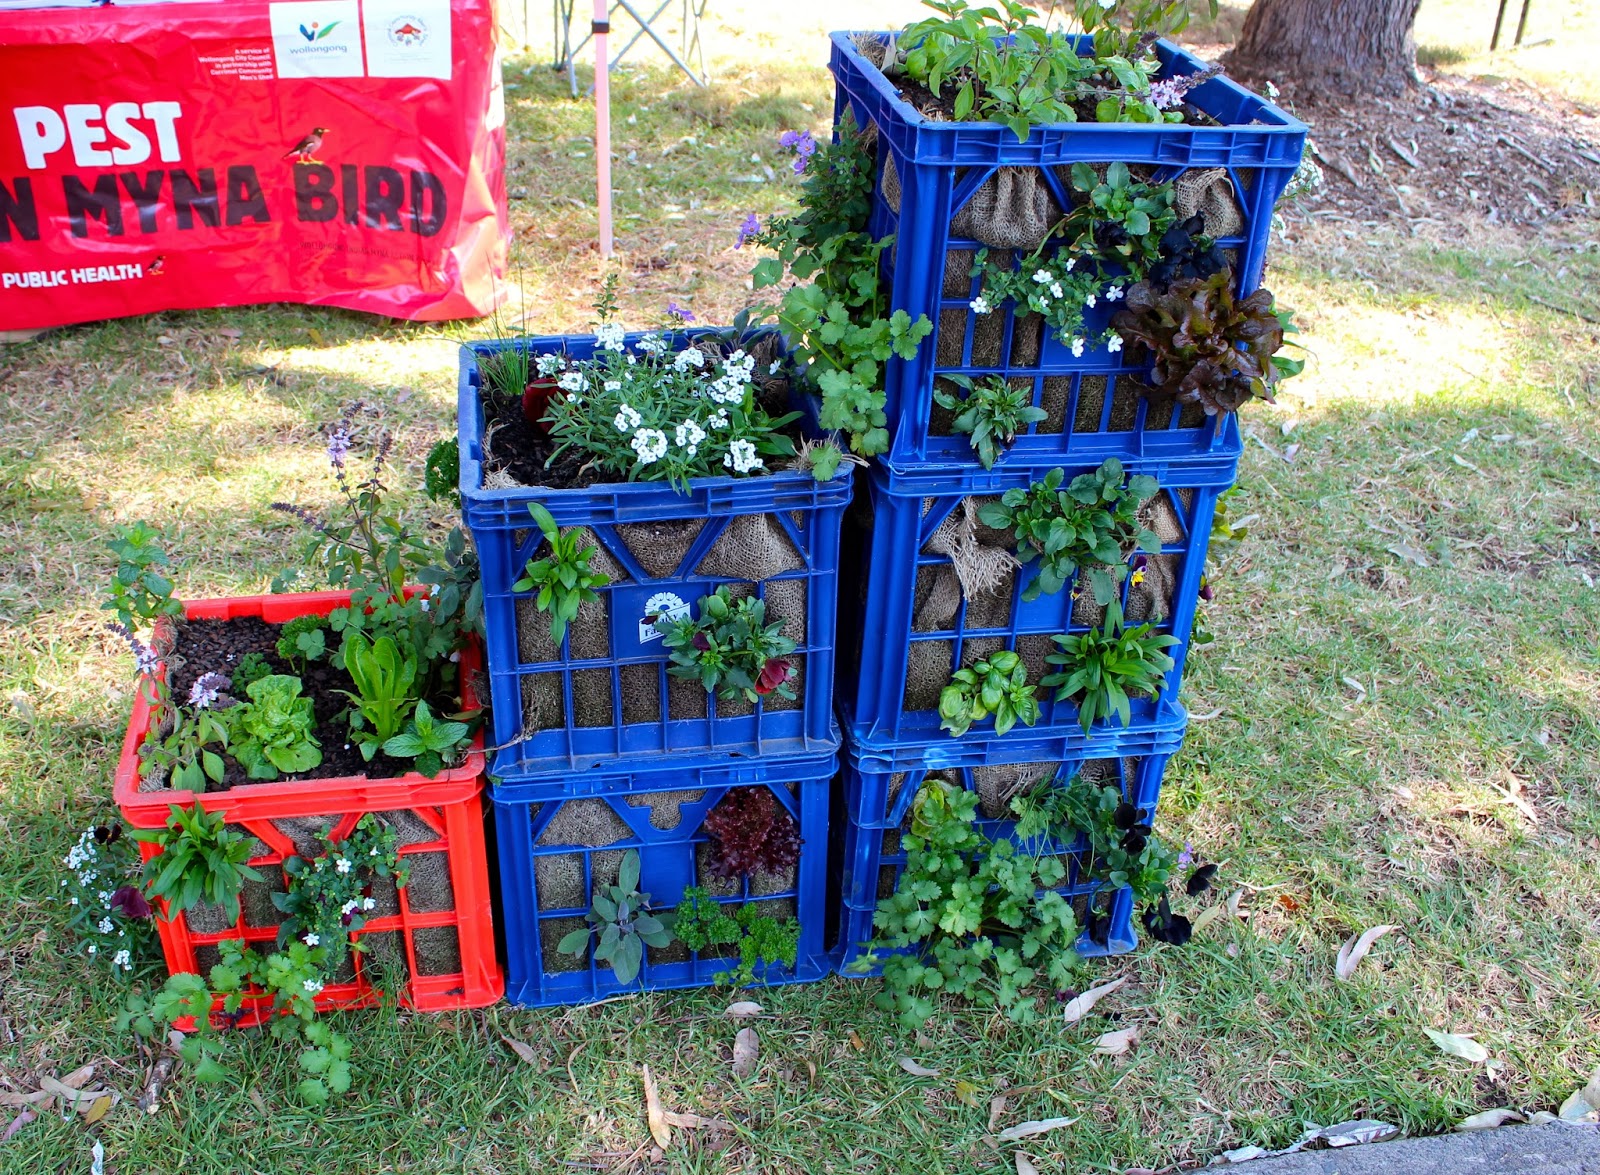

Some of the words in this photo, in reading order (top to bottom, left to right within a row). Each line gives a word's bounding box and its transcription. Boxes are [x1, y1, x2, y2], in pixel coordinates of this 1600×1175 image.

[289, 45, 348, 54] wollongong
[14, 101, 182, 170] PEST
[62, 165, 271, 238] MYNA
[293, 163, 448, 238] BIRD
[2, 268, 68, 289] PUBLIC
[70, 263, 143, 285] HEALTH
